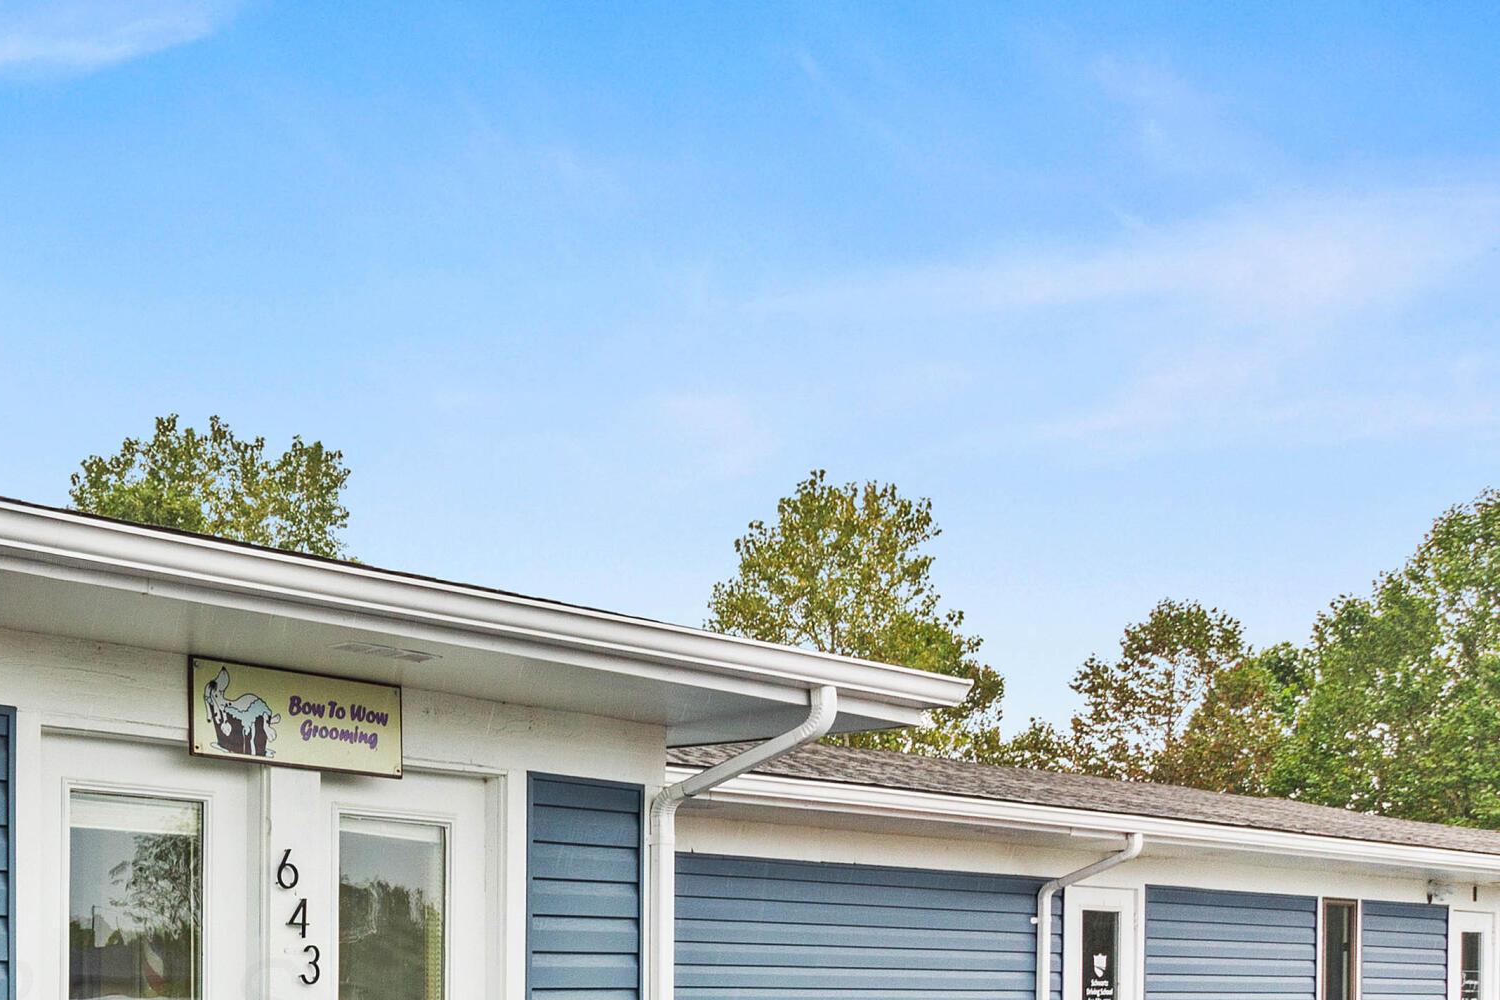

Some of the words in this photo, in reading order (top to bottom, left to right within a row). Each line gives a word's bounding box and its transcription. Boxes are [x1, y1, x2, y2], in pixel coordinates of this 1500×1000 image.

[288, 695, 325, 719] Bow
[328, 700, 346, 719] To
[349, 703, 389, 727] Wow
[299, 719, 378, 750] Grooming
